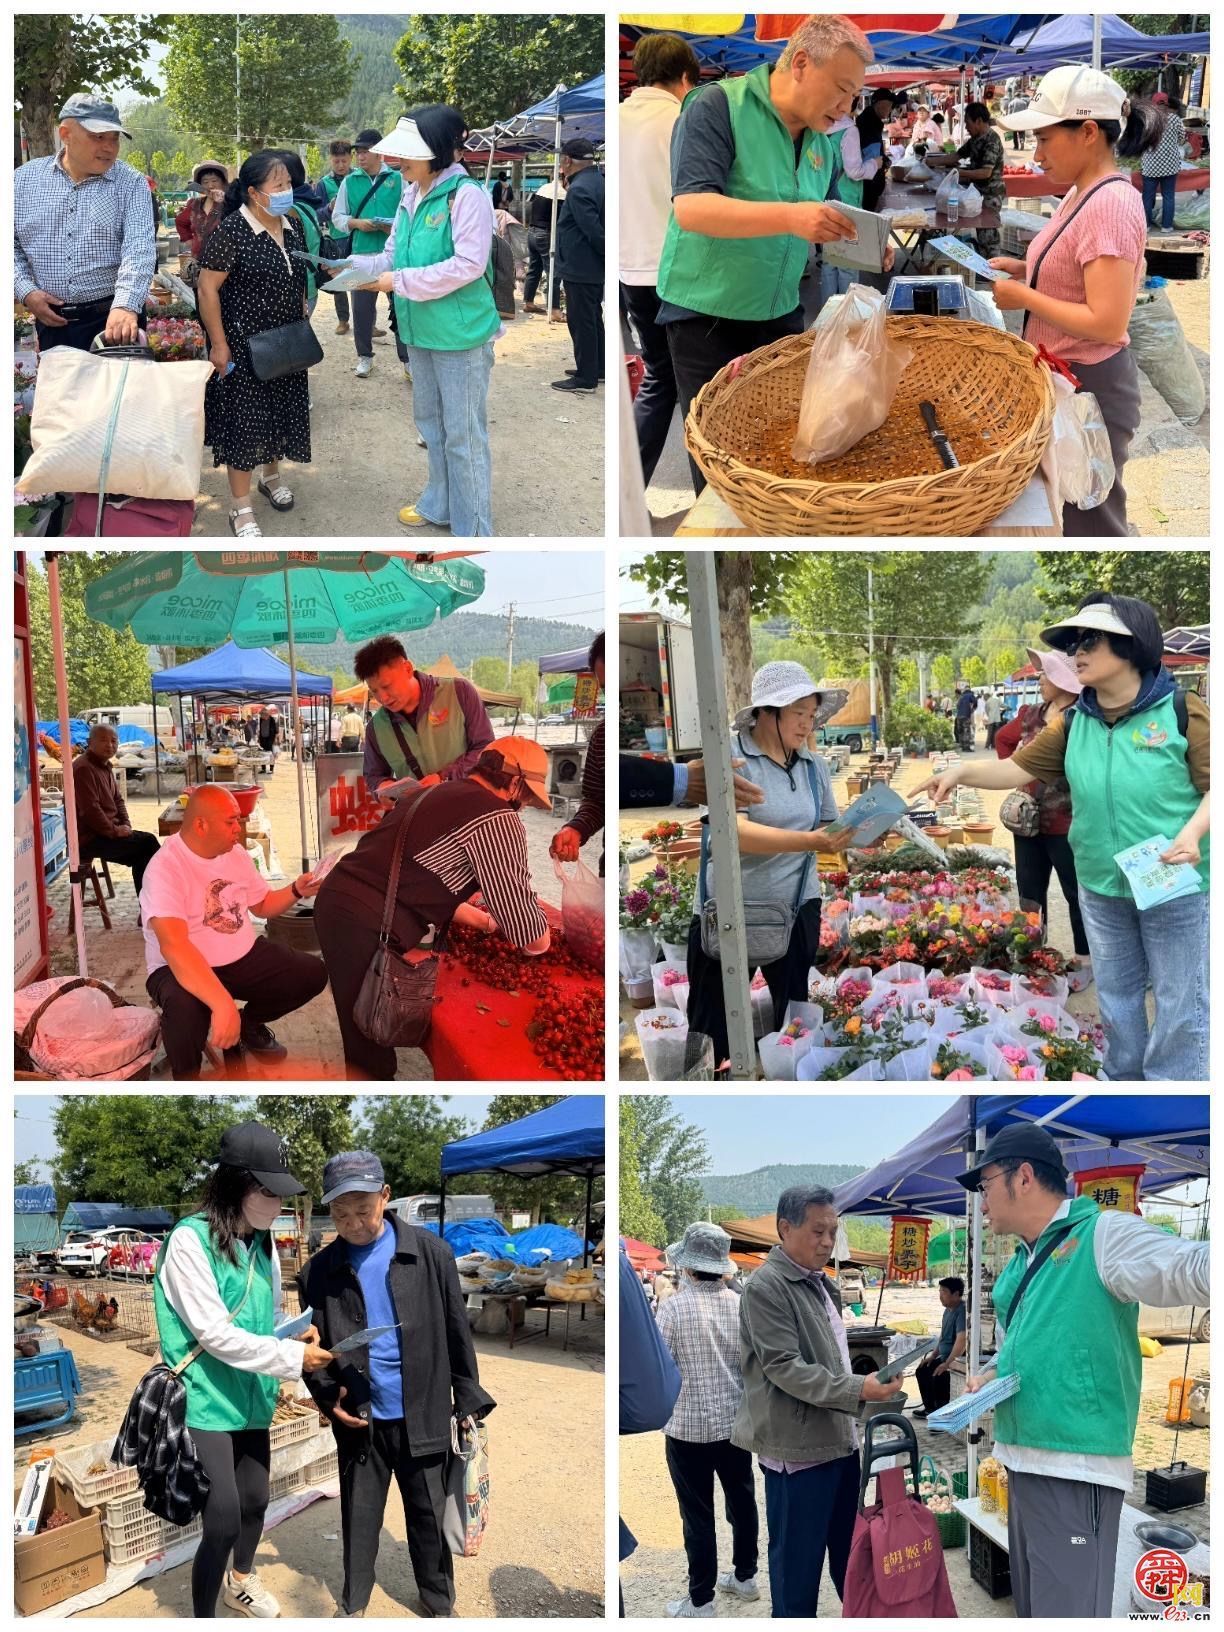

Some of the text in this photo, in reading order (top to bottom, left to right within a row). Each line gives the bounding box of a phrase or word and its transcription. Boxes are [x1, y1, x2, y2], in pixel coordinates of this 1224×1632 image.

[1092, 1187, 1122, 1206] 糖
[900, 1227, 920, 1270] 糖炒栗子
